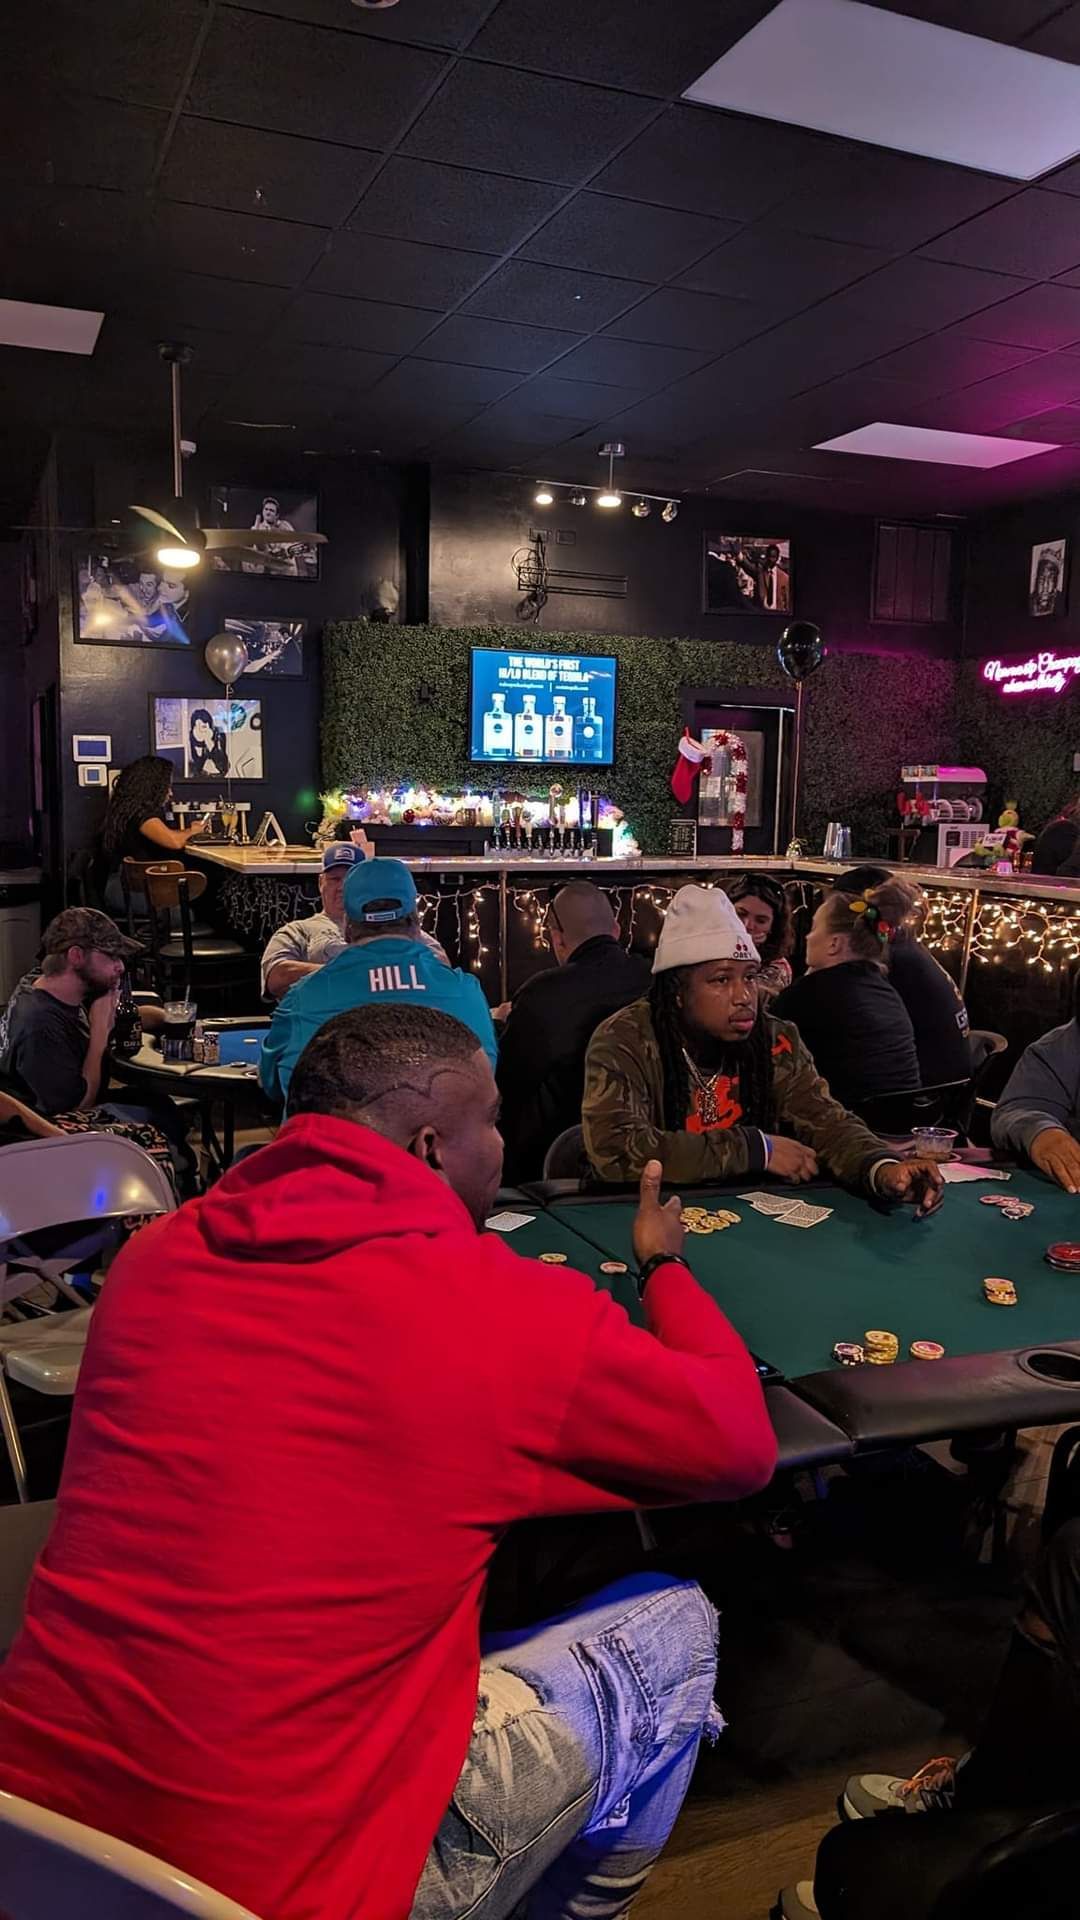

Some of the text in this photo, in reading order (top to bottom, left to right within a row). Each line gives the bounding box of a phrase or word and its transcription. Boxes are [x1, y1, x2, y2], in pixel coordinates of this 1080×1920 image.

[508, 656, 580, 671] THE WORLD'S FIRST
[522, 669, 547, 681] BLEND
[547, 670, 558, 681] OF
[368, 965, 426, 992] HILL
